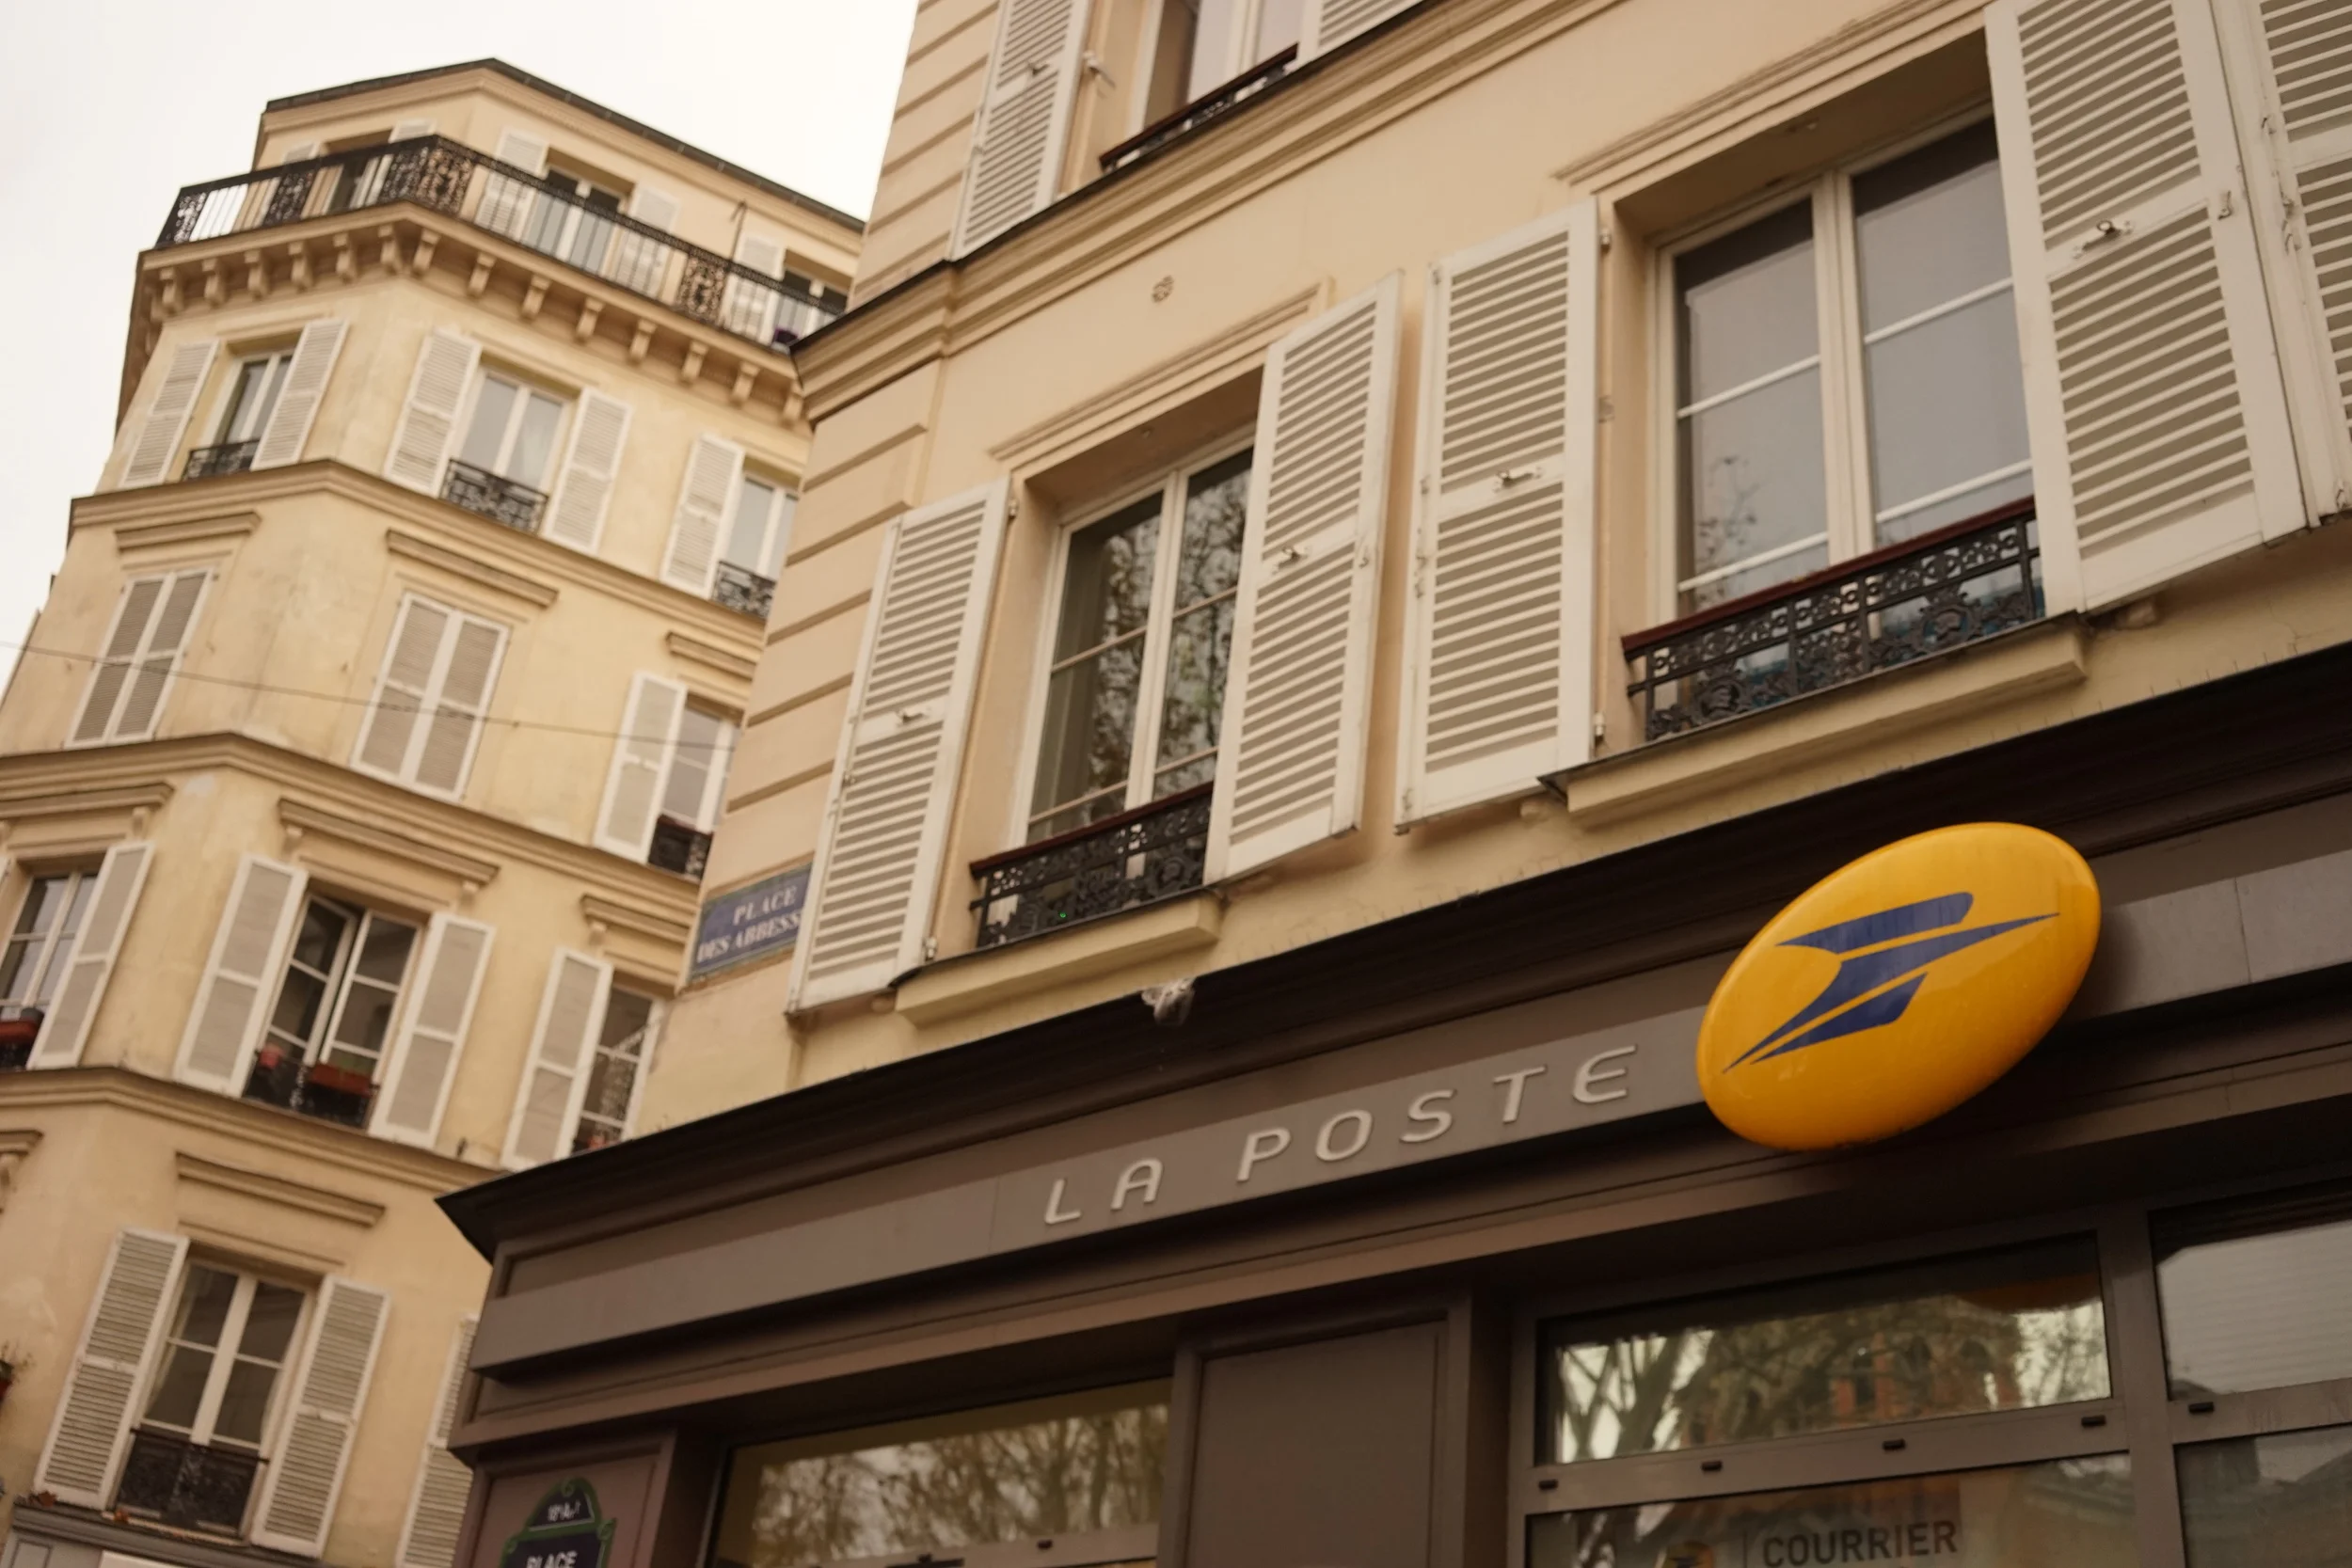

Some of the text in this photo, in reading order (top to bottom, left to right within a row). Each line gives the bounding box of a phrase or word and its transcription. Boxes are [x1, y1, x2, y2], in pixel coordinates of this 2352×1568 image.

[733, 885, 798, 926] PLACE
[696, 935, 731, 963] DES
[1043, 1044, 1637, 1225] LA POSTE
[1764, 1519, 1958, 1567] COURRIER
